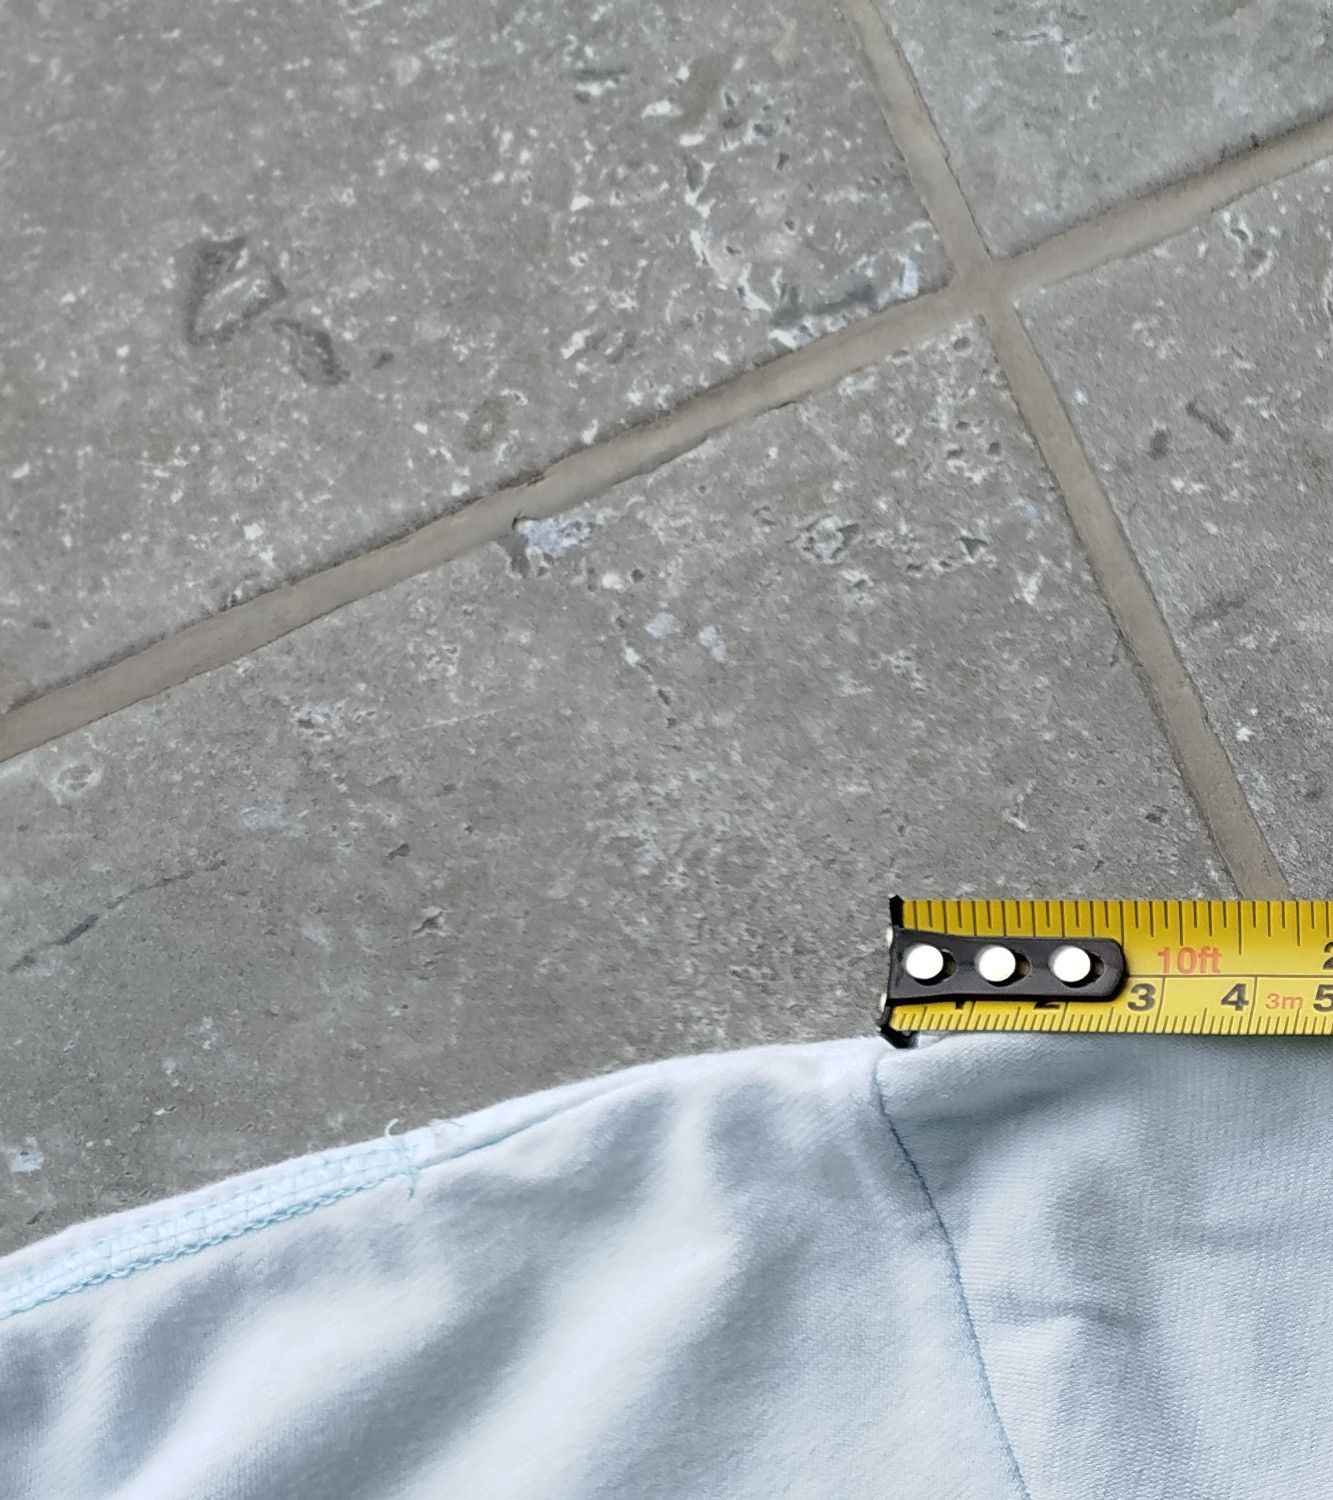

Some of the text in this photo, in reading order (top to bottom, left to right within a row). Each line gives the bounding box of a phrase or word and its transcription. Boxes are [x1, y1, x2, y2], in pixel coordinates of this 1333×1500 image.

[1157, 945, 1221, 974] 10ft
[1127, 983, 1157, 1011] 3
[1220, 983, 1249, 1011] 4
[1264, 993, 1303, 1010] 3m
